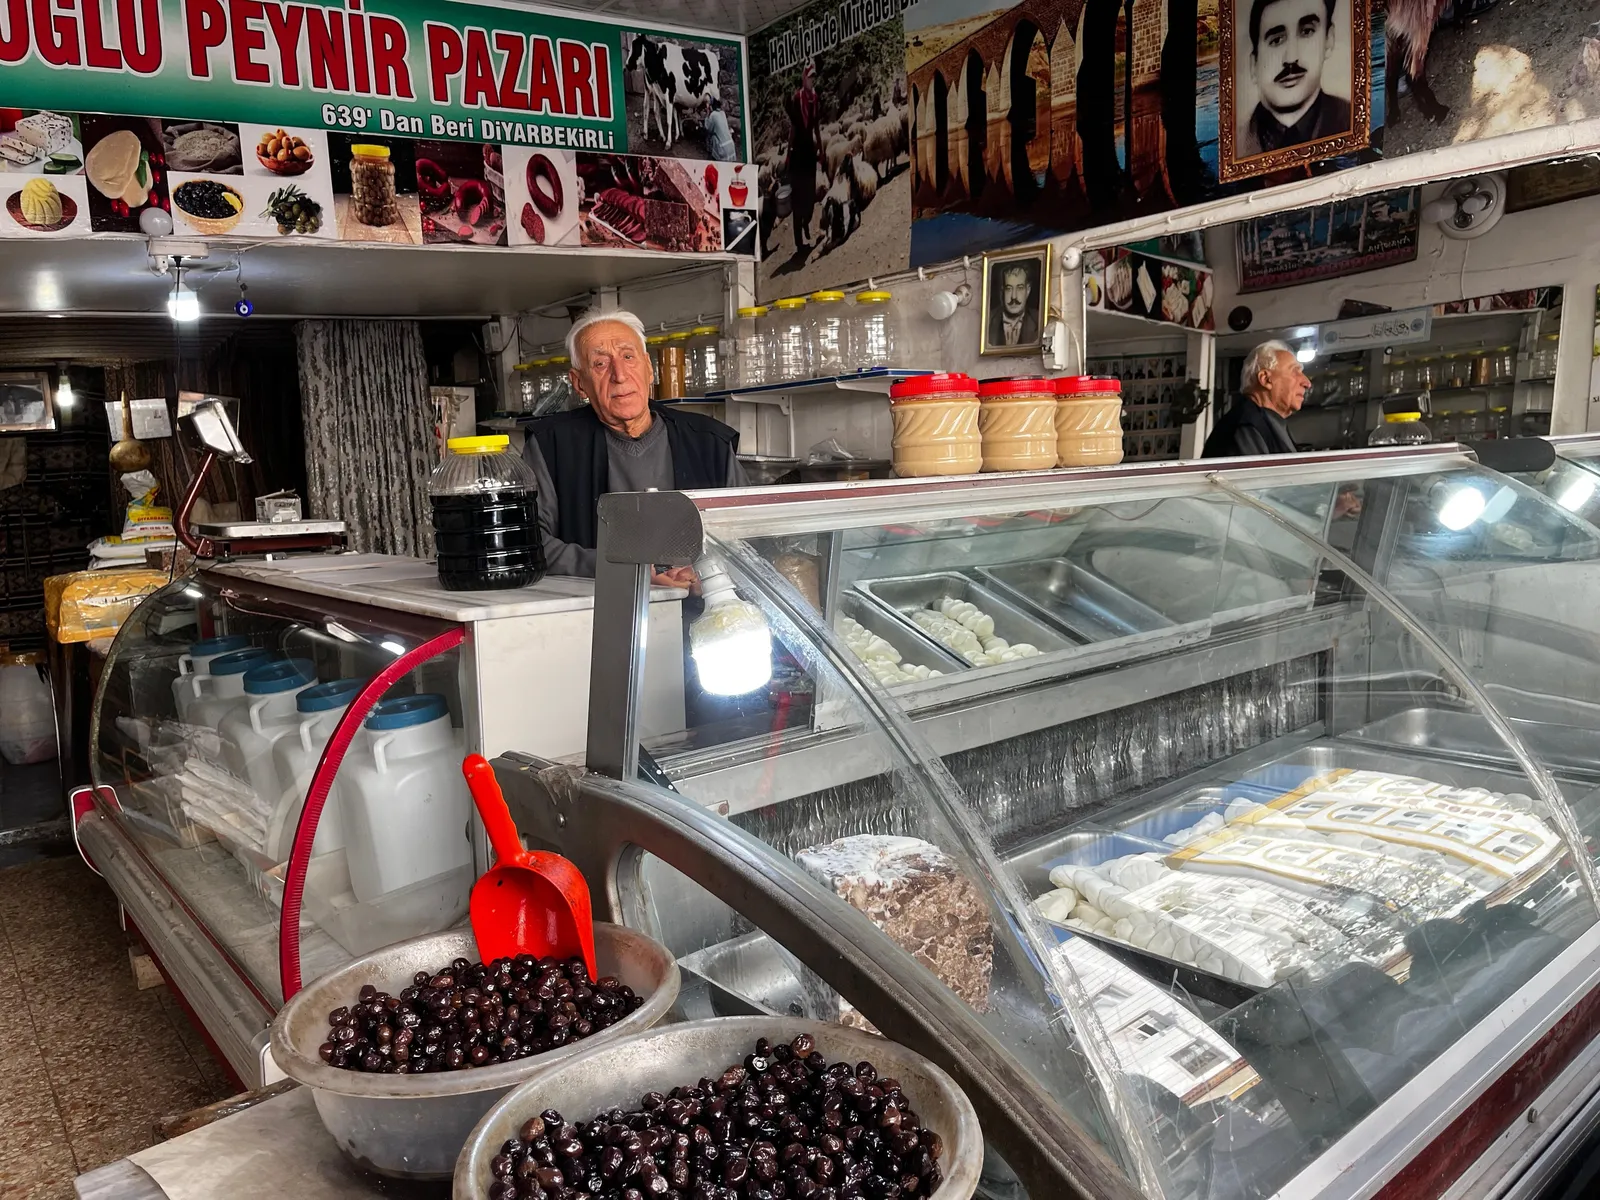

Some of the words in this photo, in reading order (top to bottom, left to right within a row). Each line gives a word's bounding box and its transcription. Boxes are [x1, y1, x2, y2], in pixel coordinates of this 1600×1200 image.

[183, 0, 417, 99] PEYNİR
[424, 22, 614, 121] PAZARI
[768, 30, 798, 75] Halk
[798, 11, 838, 67] İçinde
[379, 107, 424, 135] Dan
[430, 113, 475, 139] Beri
